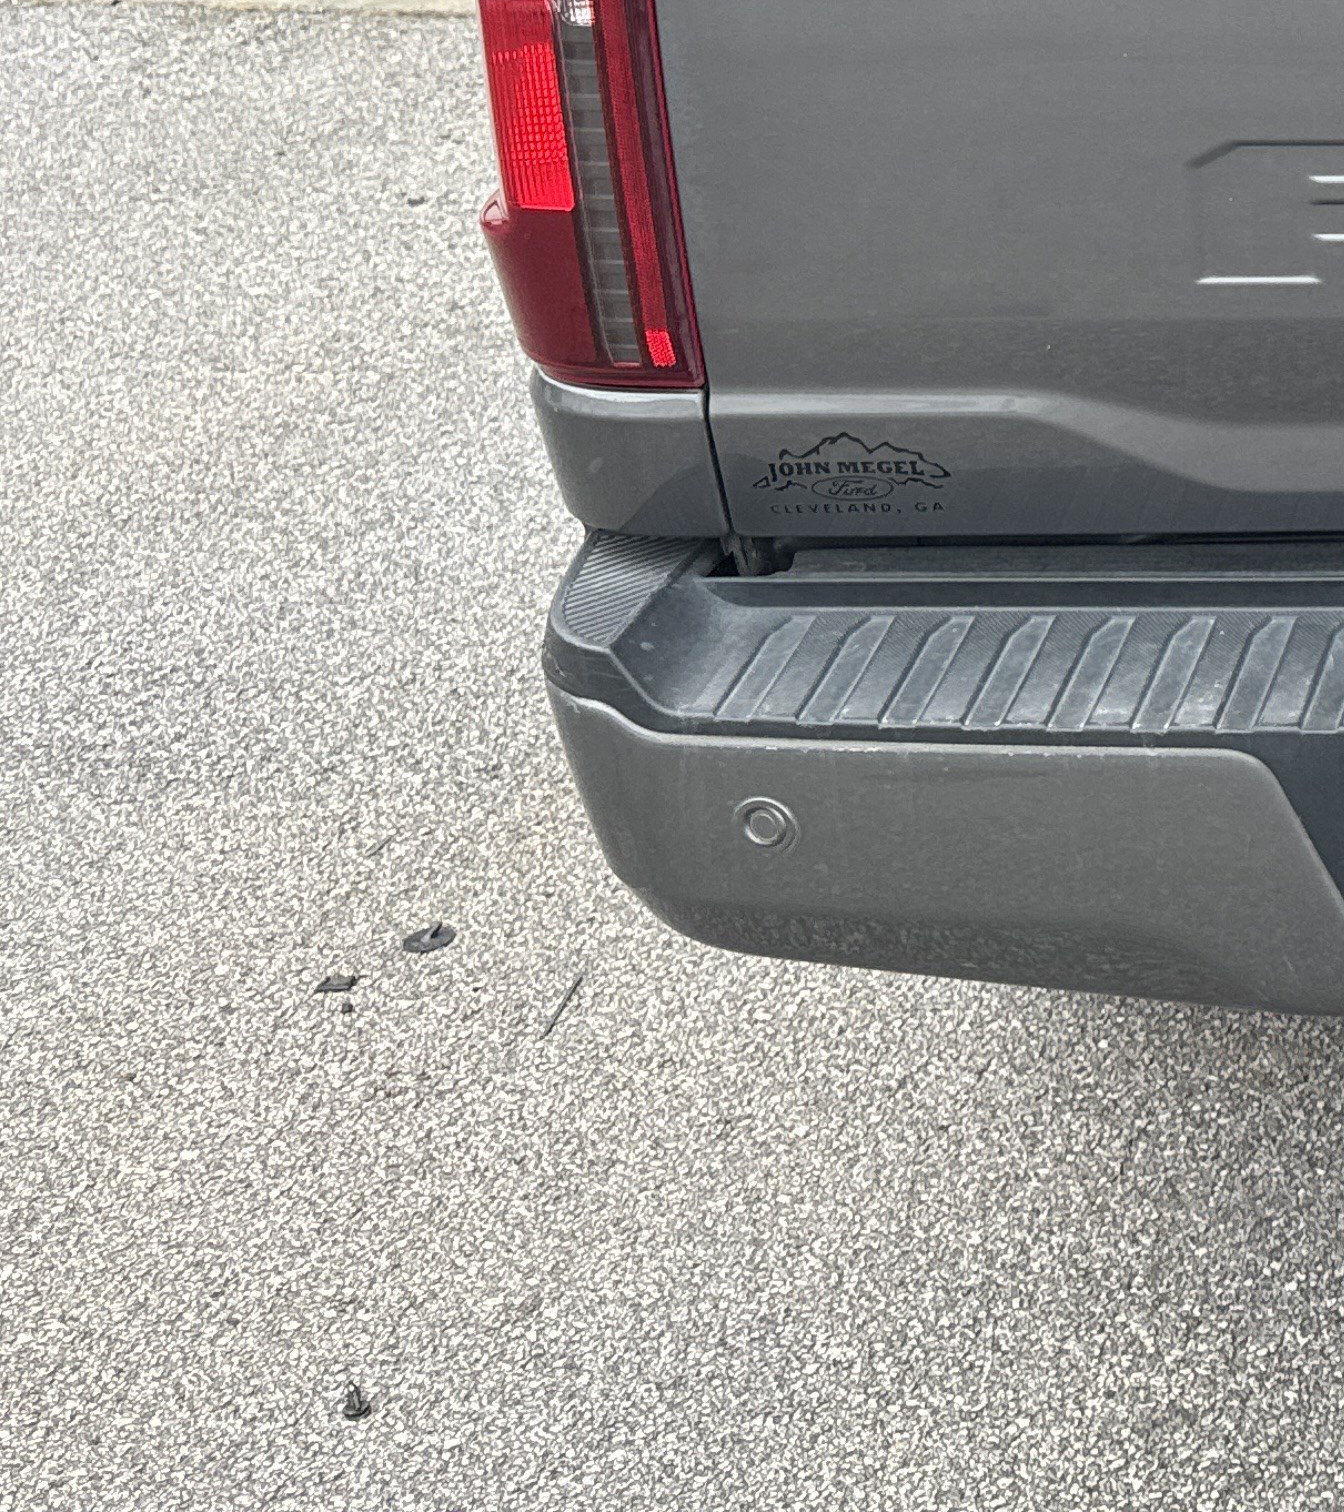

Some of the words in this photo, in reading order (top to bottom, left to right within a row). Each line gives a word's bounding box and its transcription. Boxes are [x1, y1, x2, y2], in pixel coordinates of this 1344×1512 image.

[768, 461, 831, 482] JOHN
[837, 460, 925, 476] MEGEL
[827, 479, 878, 496] Ford
[769, 502, 902, 514] CLEVELAND,
[914, 501, 945, 512] GA
